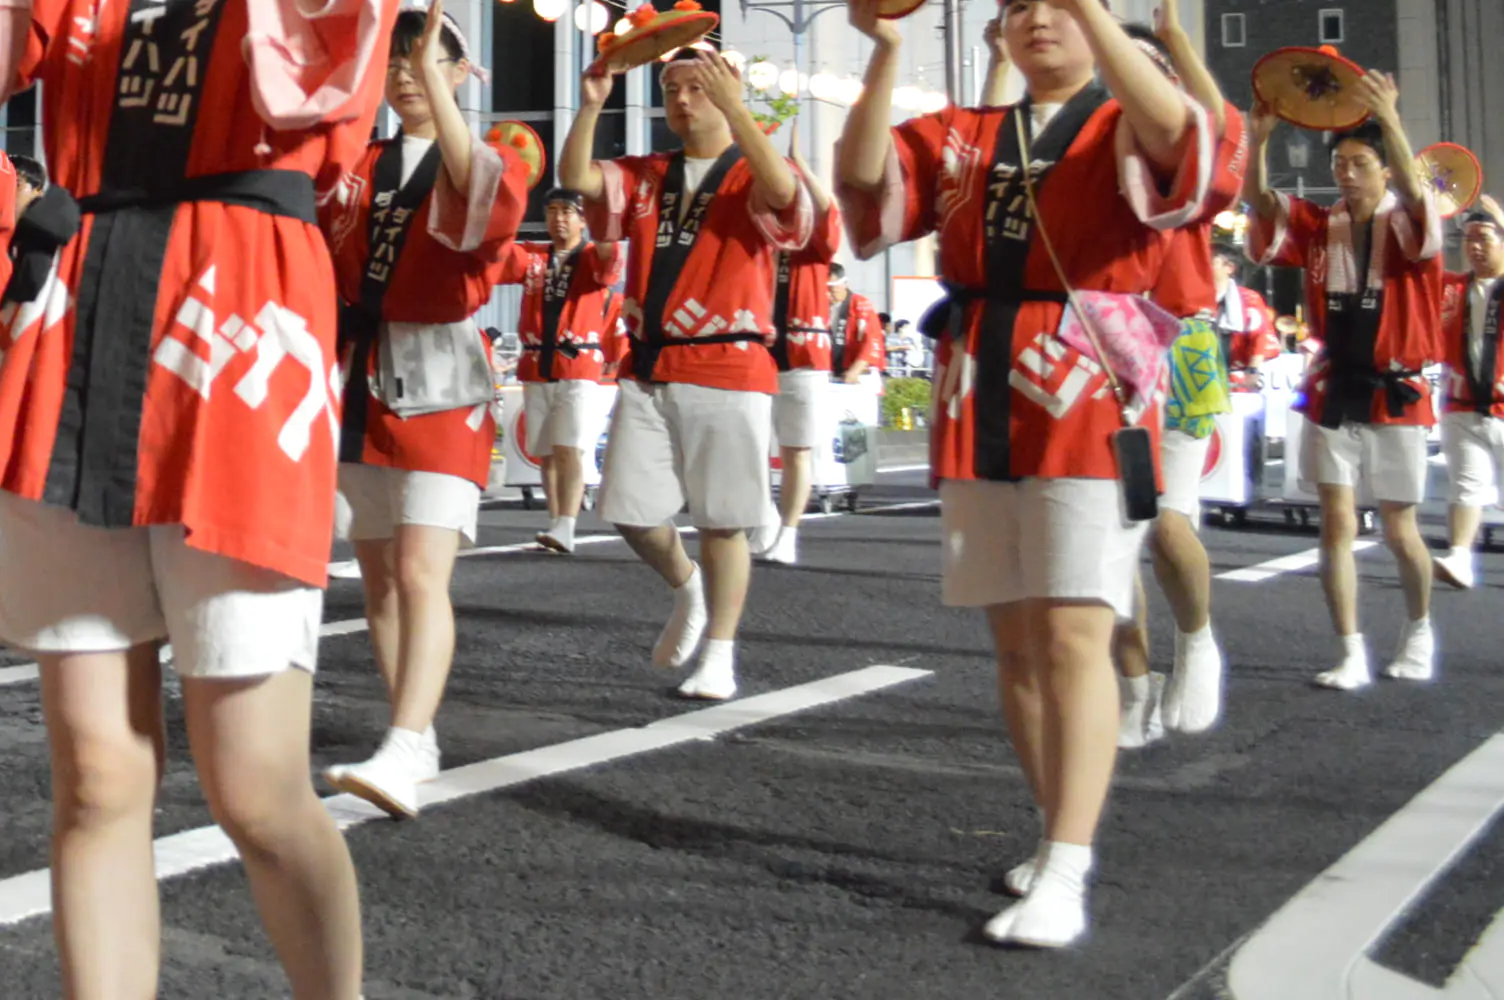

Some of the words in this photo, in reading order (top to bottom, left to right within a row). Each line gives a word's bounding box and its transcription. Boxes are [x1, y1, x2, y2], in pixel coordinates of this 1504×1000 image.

[367, 205, 413, 283] ダイハツ
[655, 192, 679, 248] ダイハツ
